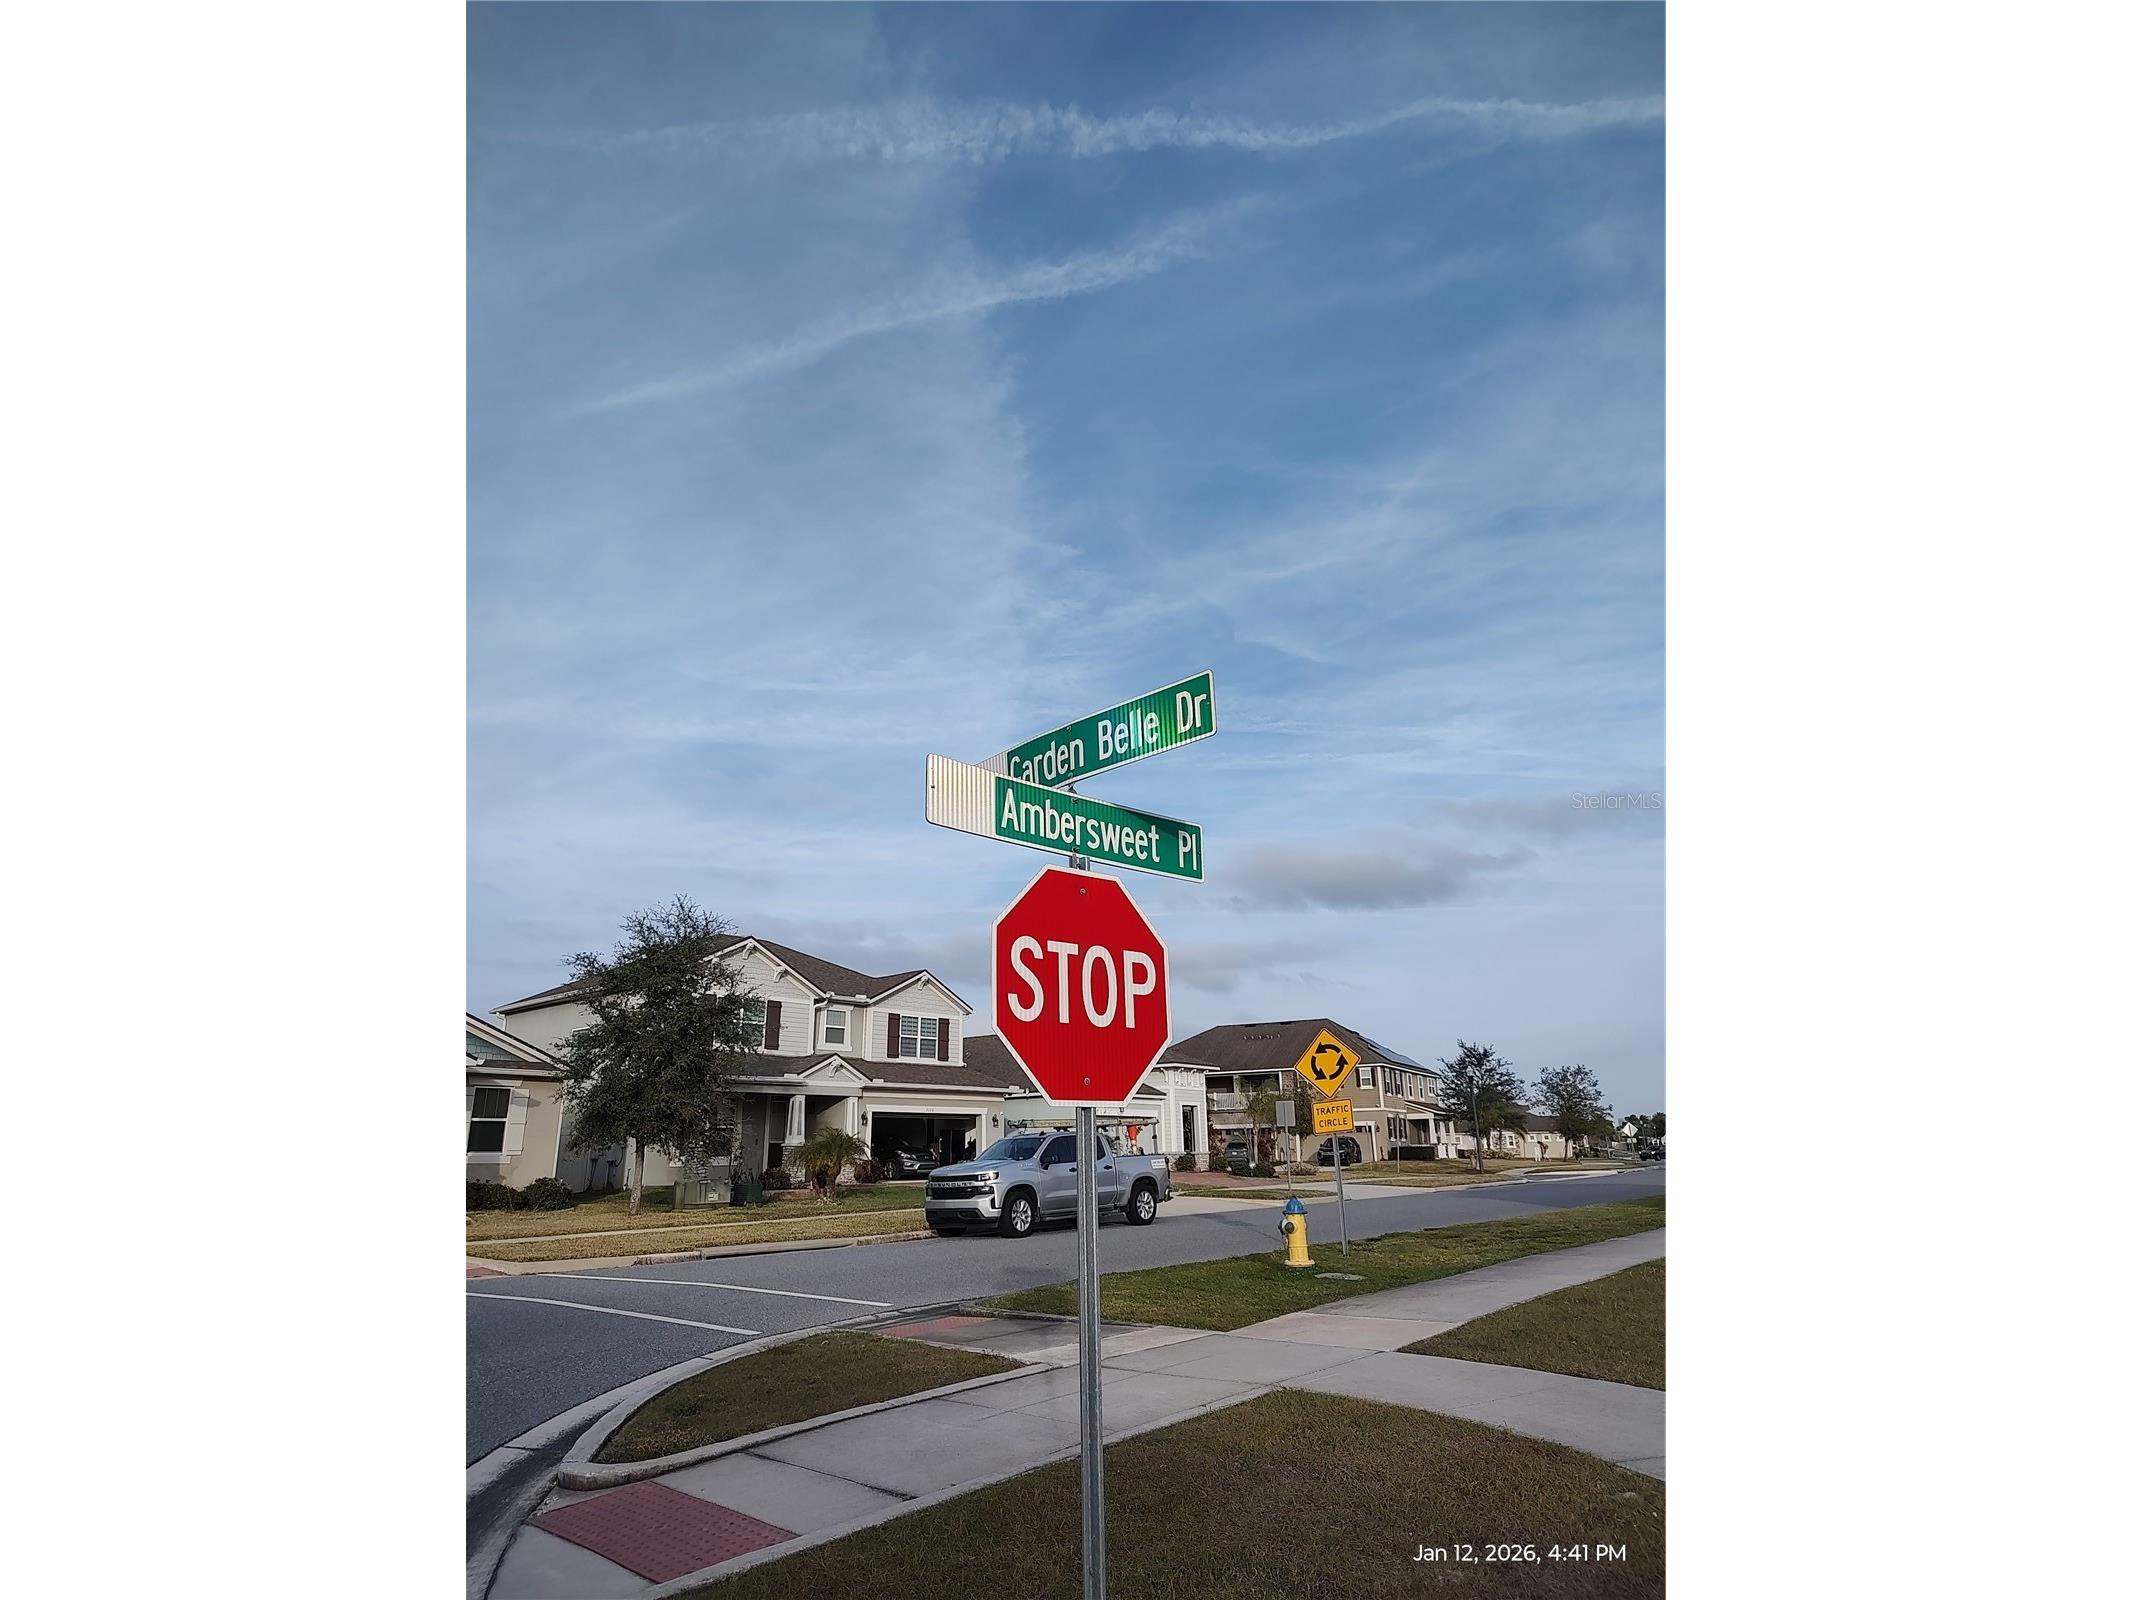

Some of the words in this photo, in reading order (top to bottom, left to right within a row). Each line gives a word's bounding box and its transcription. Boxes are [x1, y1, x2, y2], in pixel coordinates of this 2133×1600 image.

[1098, 708, 1160, 761] Belle
[1176, 691, 1207, 734] Dr
[1001, 789, 1160, 862] Ambersweet
[1178, 830, 1197, 870] Pl
[1008, 936, 1156, 1029] STOP
[1316, 1105, 1349, 1115] TRAFFIC
[1319, 1118, 1348, 1127] CIRCLE
